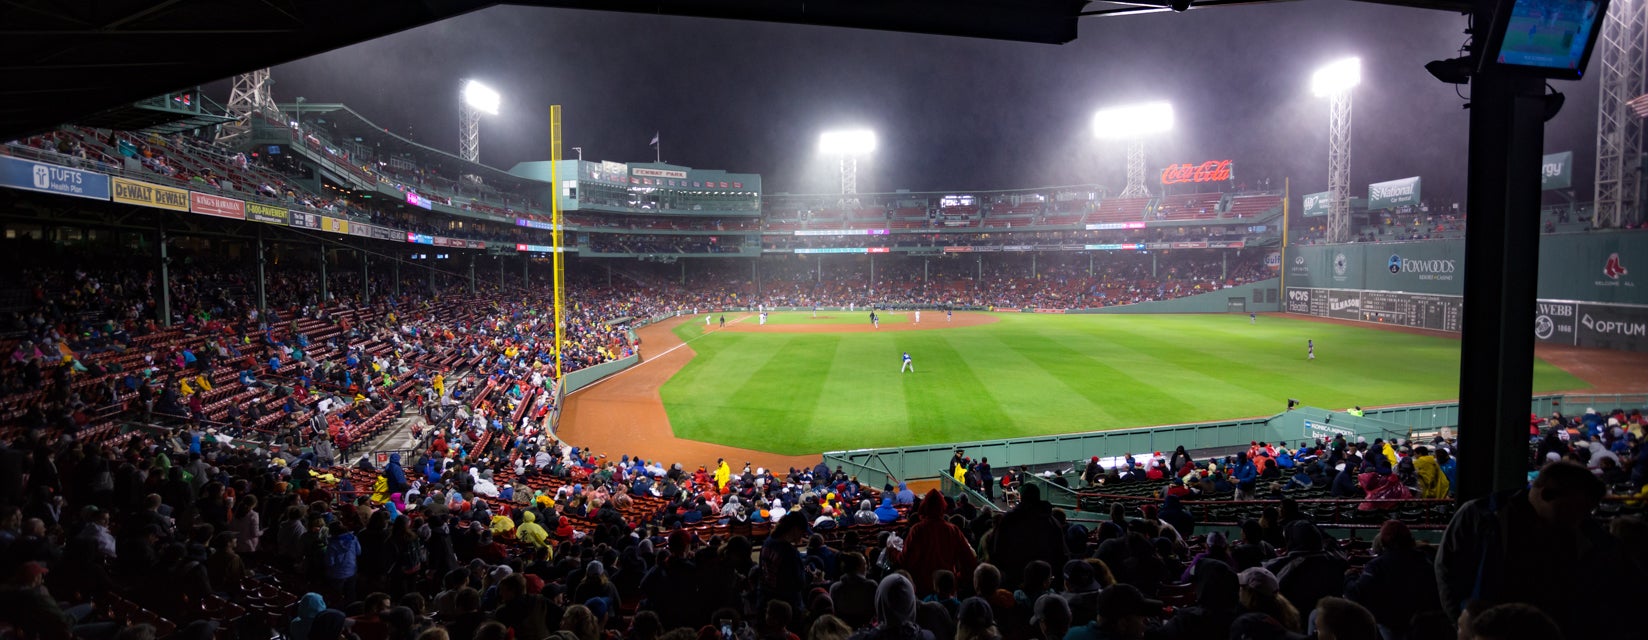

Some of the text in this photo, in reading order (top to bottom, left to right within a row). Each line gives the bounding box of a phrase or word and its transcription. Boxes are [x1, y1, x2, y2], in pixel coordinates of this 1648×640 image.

[49, 167, 82, 184] TUFTS
[1162, 160, 1232, 185] Coca-Cola
[1542, 162, 1562, 177] rgy
[50, 181, 83, 193] Health Plan
[1380, 183, 1414, 198] National
[1265, 254, 1281, 265] Gulf
[1402, 258, 1456, 273] FOXWOODS
[1295, 290, 1309, 302] CVS
[1289, 300, 1309, 313] Health
[1539, 304, 1572, 317] WEBB
[1595, 320, 1646, 336] OPTUM
[1311, 423, 1331, 432] KONICA
